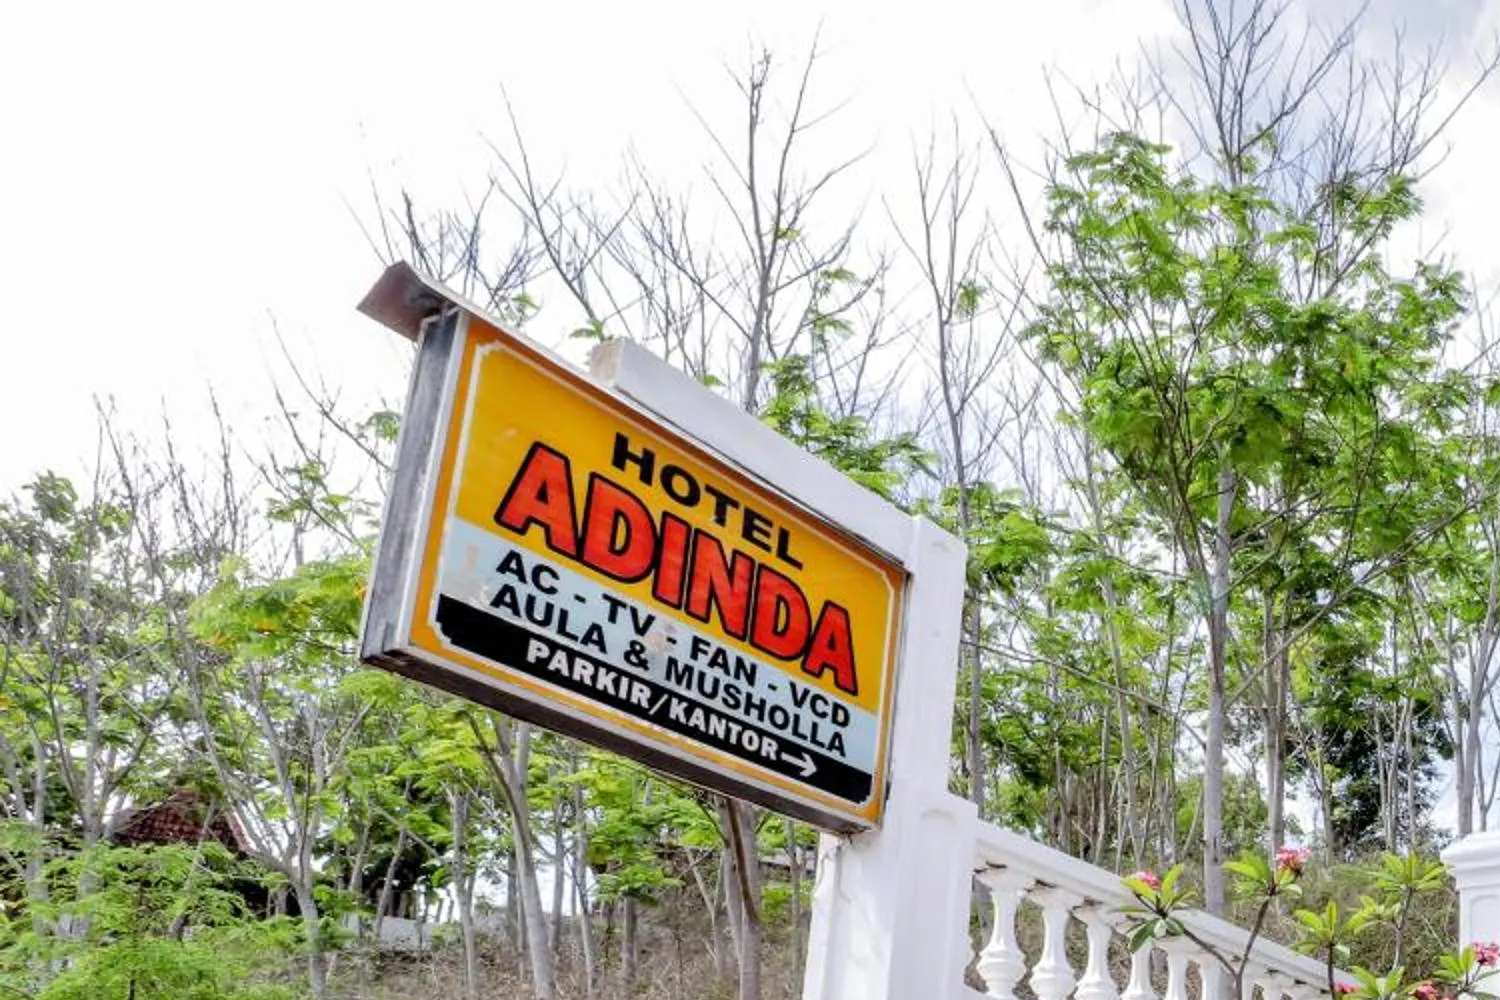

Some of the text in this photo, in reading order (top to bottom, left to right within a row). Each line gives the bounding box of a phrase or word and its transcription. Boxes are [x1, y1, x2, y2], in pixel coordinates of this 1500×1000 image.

[493, 441, 859, 697] ADINDA
[611, 432, 804, 570] HOTEL
[489, 583, 847, 759] AULA & MUSHOLLA
[495, 549, 561, 595] AC
[602, 593, 656, 637] TV
[689, 635, 758, 688] FAN
[788, 680, 851, 729] VCD
[526, 637, 780, 761] PARKIR/KANTOR
